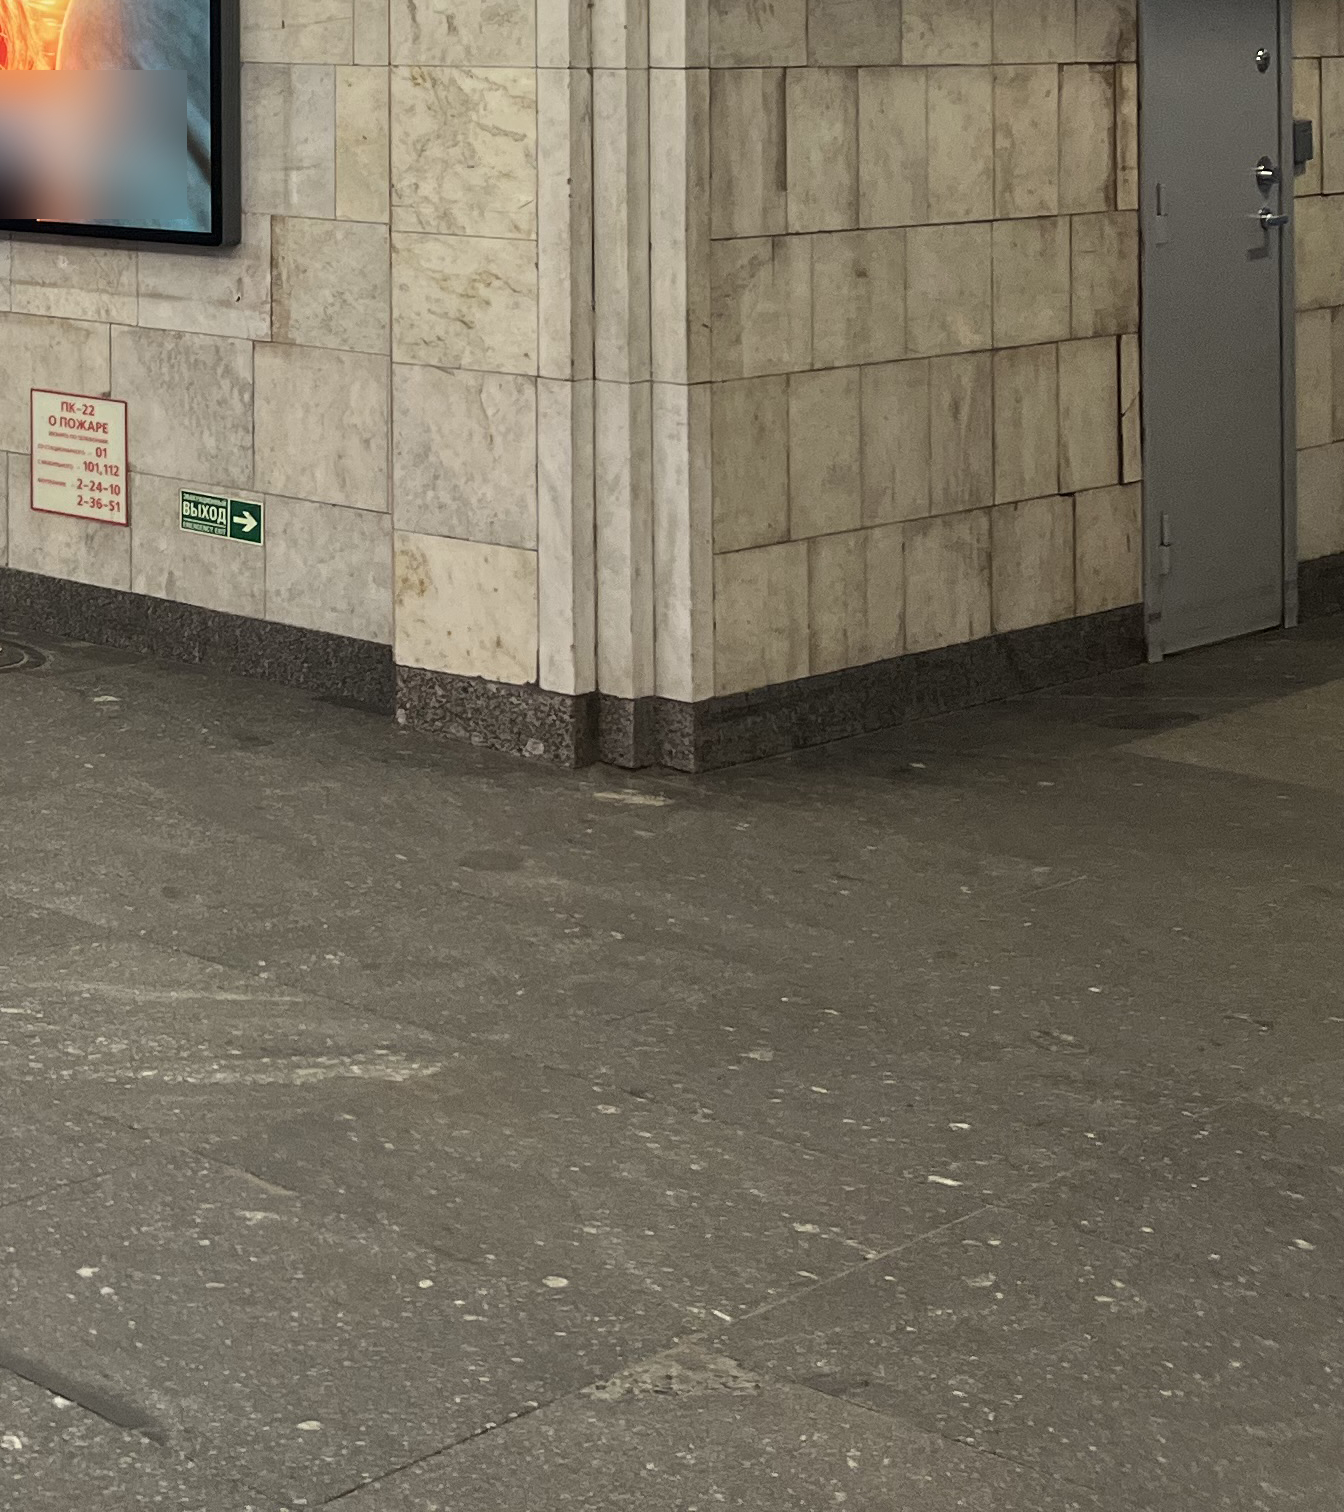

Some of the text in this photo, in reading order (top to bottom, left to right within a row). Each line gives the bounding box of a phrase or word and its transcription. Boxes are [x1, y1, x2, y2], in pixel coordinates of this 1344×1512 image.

[61, 401, 95, 416] ПК-22
[48, 415, 108, 434] О ПОЖАРЕ
[95, 447, 107, 458] 01
[77, 478, 121, 496] 2-24-10
[77, 495, 121, 512] 2-36-51
[183, 501, 227, 525] ВЫХОД
